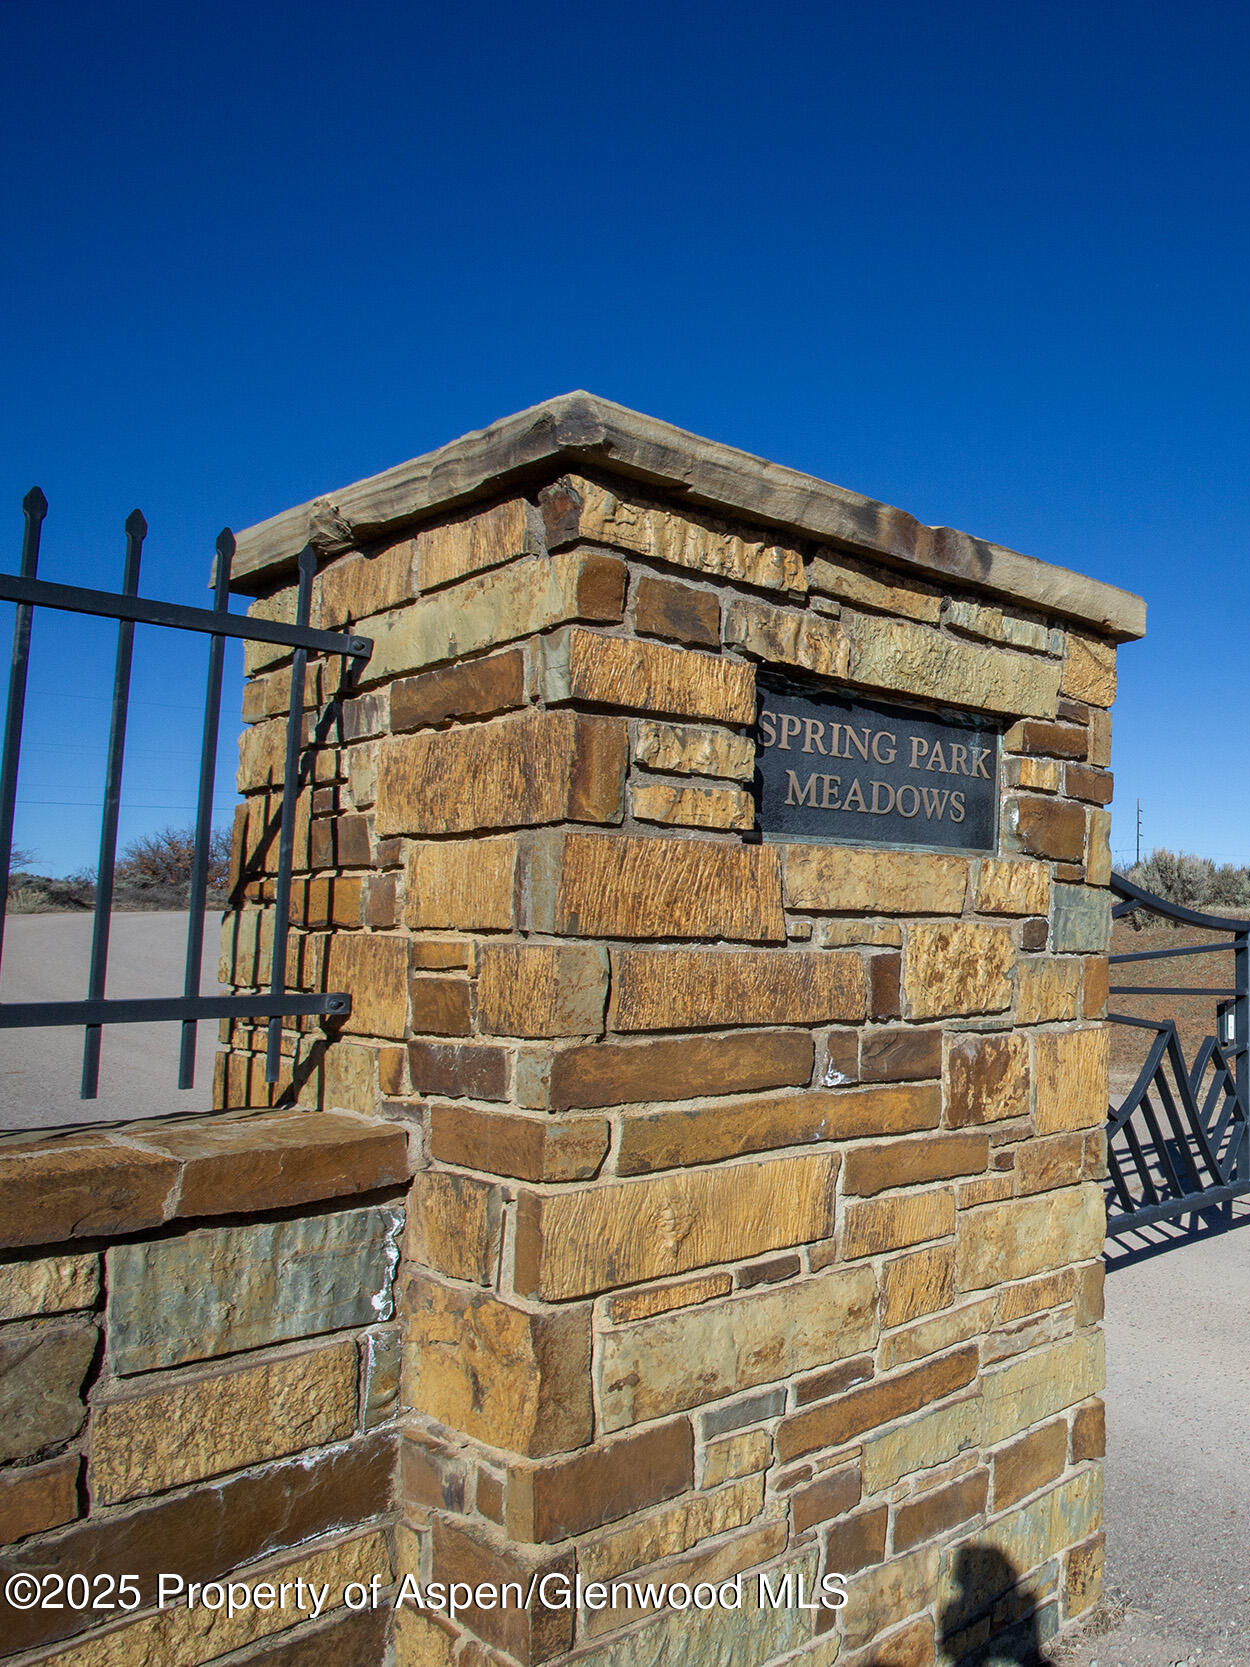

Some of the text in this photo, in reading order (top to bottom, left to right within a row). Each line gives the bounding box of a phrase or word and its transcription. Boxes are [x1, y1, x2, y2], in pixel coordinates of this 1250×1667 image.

[758, 710, 992, 779] SPRING PARK
[784, 769, 966, 823] MEADOWS
